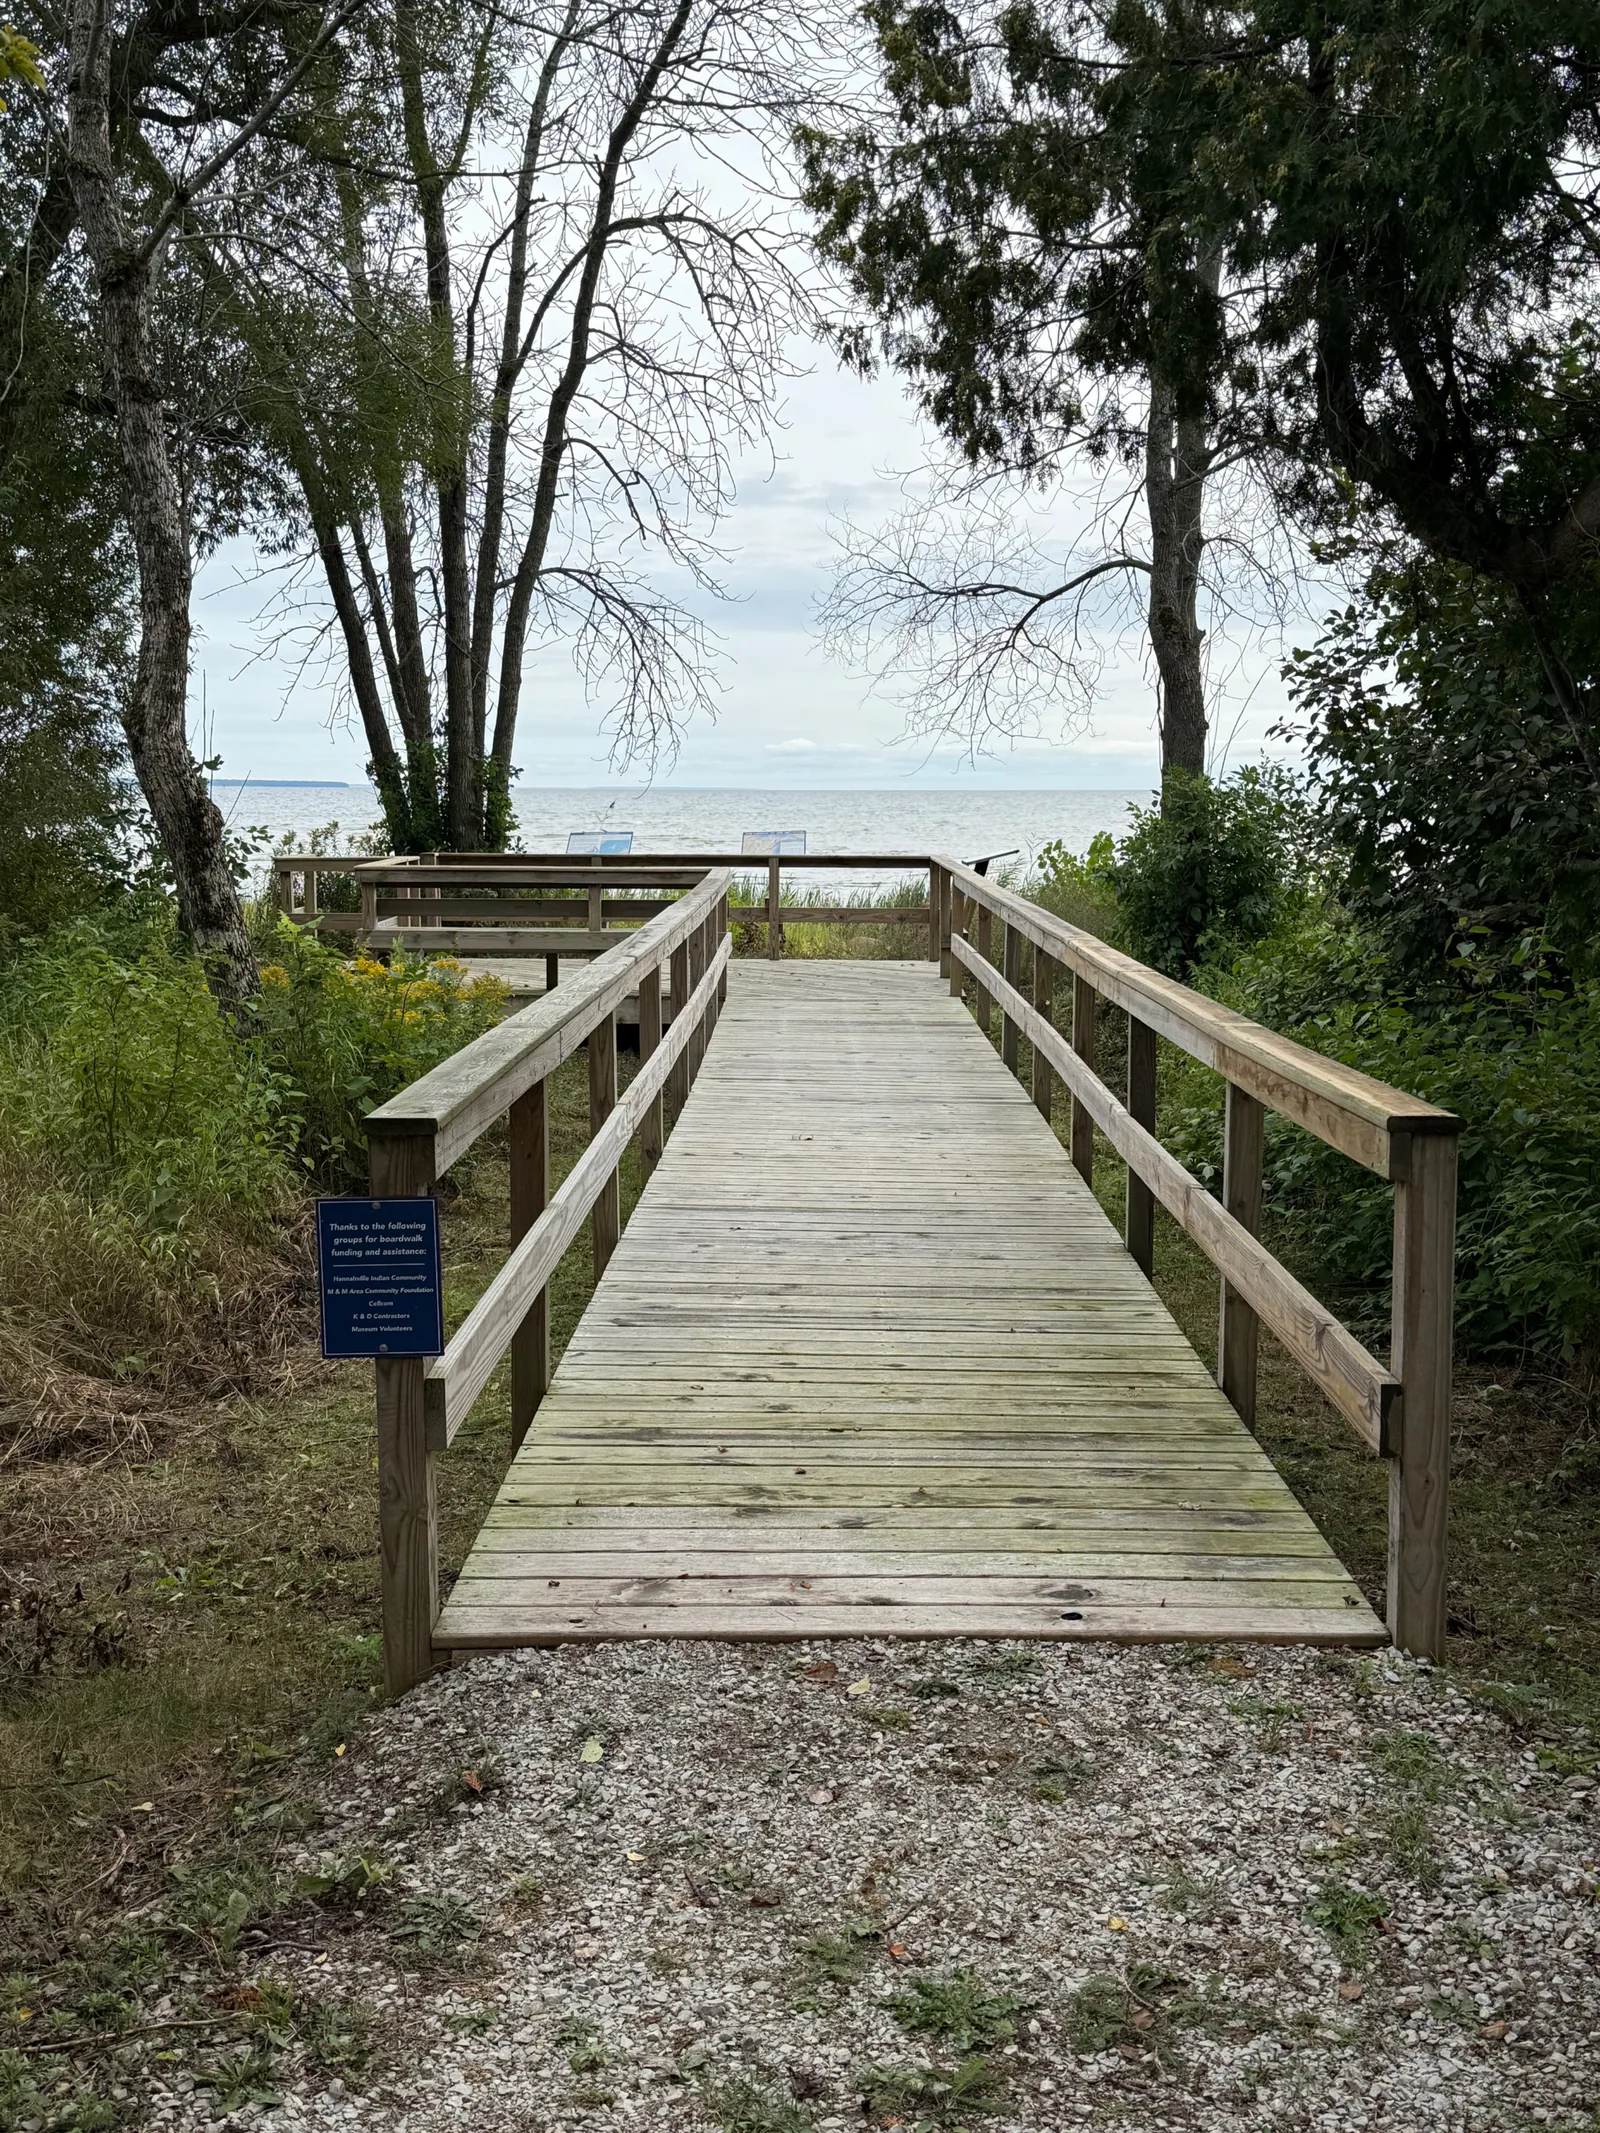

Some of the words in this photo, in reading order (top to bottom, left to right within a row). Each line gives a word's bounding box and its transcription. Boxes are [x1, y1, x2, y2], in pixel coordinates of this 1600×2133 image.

[388, 1222, 426, 1231] following
[334, 1237, 362, 1245] groups
[365, 1235, 377, 1243] for
[380, 1234, 423, 1242] boardwalk
[331, 1249, 363, 1257] funding
[365, 1248, 380, 1256] and
